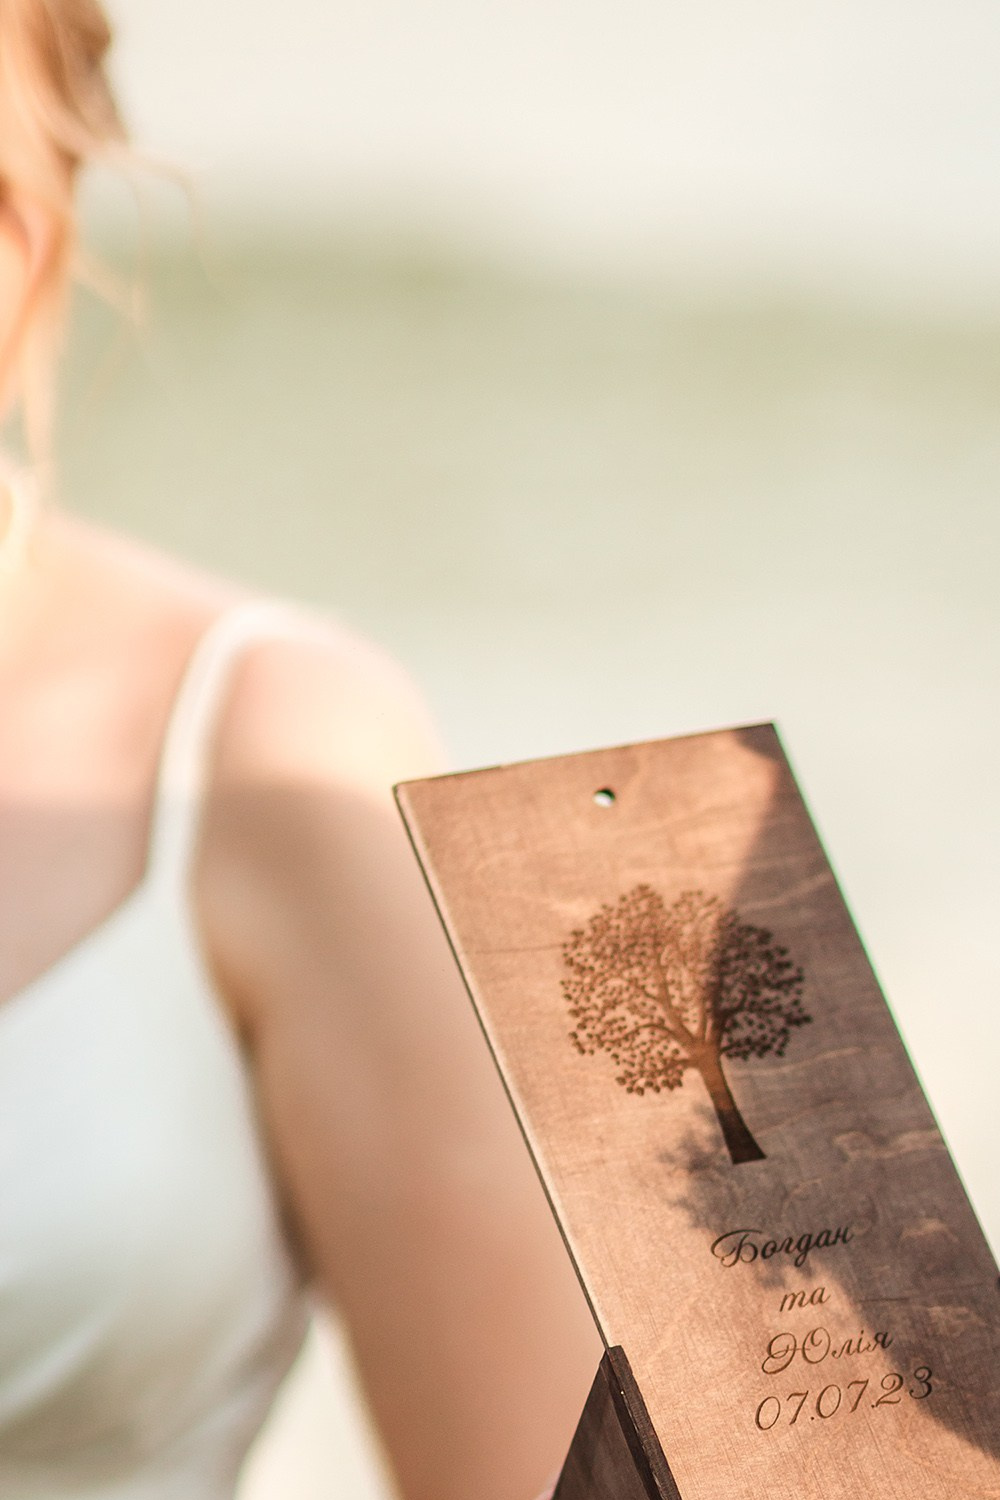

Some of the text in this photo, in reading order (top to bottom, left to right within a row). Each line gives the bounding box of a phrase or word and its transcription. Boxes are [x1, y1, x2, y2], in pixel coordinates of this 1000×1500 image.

[710, 1226, 855, 1267] Богдан
[779, 1287, 831, 1312] та
[761, 1327, 893, 1375] Юлія
[755, 1366, 932, 1430] 07.07.23
